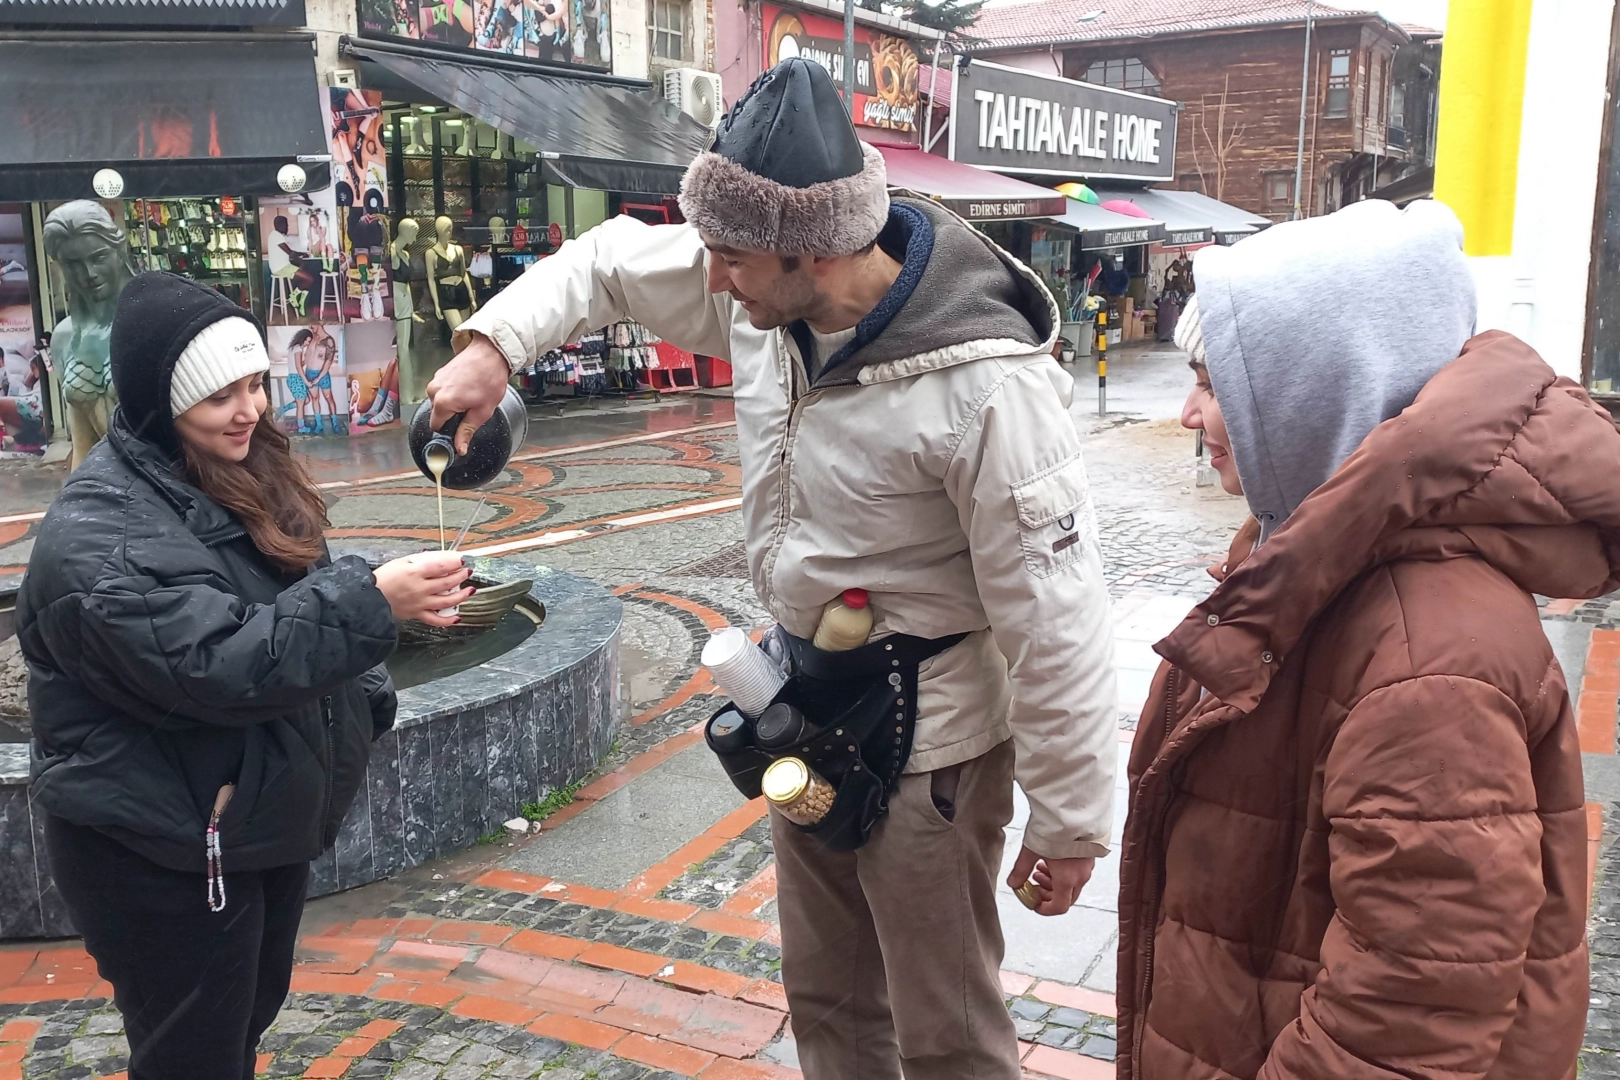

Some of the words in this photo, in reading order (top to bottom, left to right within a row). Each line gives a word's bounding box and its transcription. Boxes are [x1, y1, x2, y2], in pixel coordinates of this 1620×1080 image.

[974, 89, 1109, 160] TAHTAKALE
[1112, 113, 1162, 164] HOME
[969, 201, 1002, 217] EDİRNE
[1003, 200, 1026, 216] SİMİT
[1136, 229, 1149, 241] HOME
